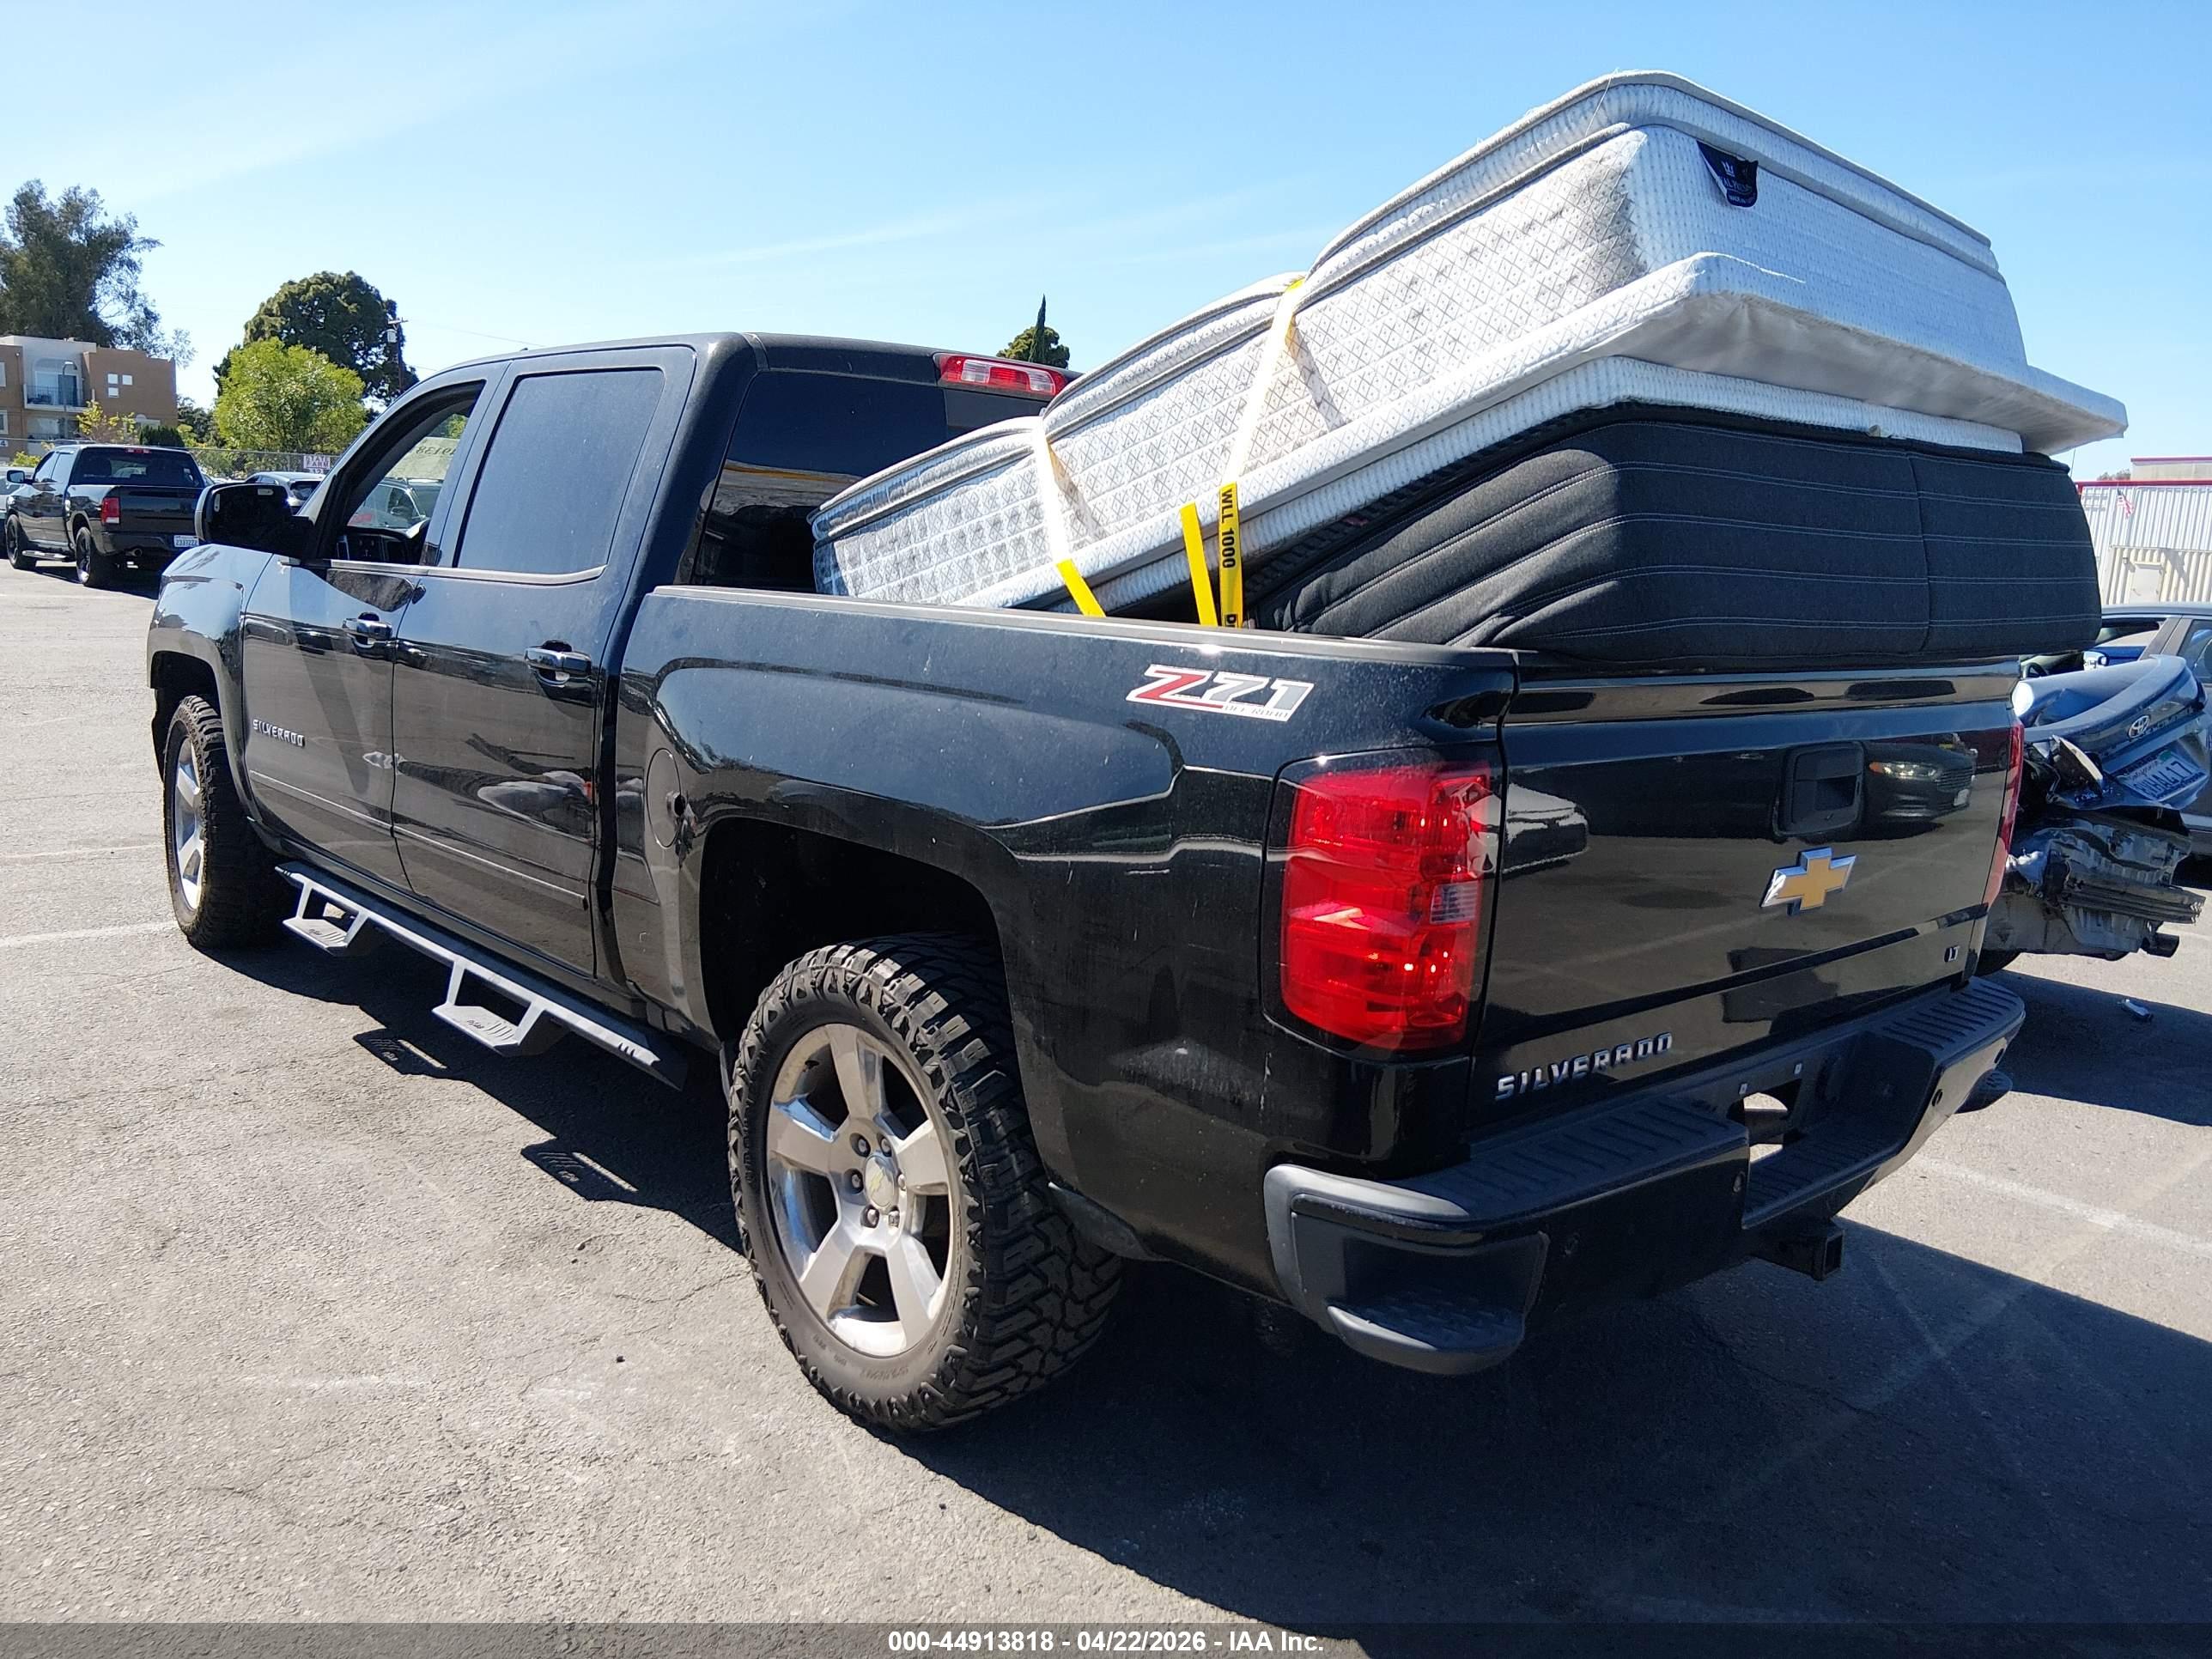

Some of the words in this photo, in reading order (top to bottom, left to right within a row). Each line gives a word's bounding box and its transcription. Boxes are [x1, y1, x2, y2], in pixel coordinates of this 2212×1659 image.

[1221, 488, 1234, 524] WLL
[1221, 527, 1237, 568] 1000
[1126, 664, 1315, 720] Z71
[252, 718, 305, 747] SILVERADO
[1948, 945, 1960, 962] LT
[1494, 1032, 1674, 1100] SILVERADO
